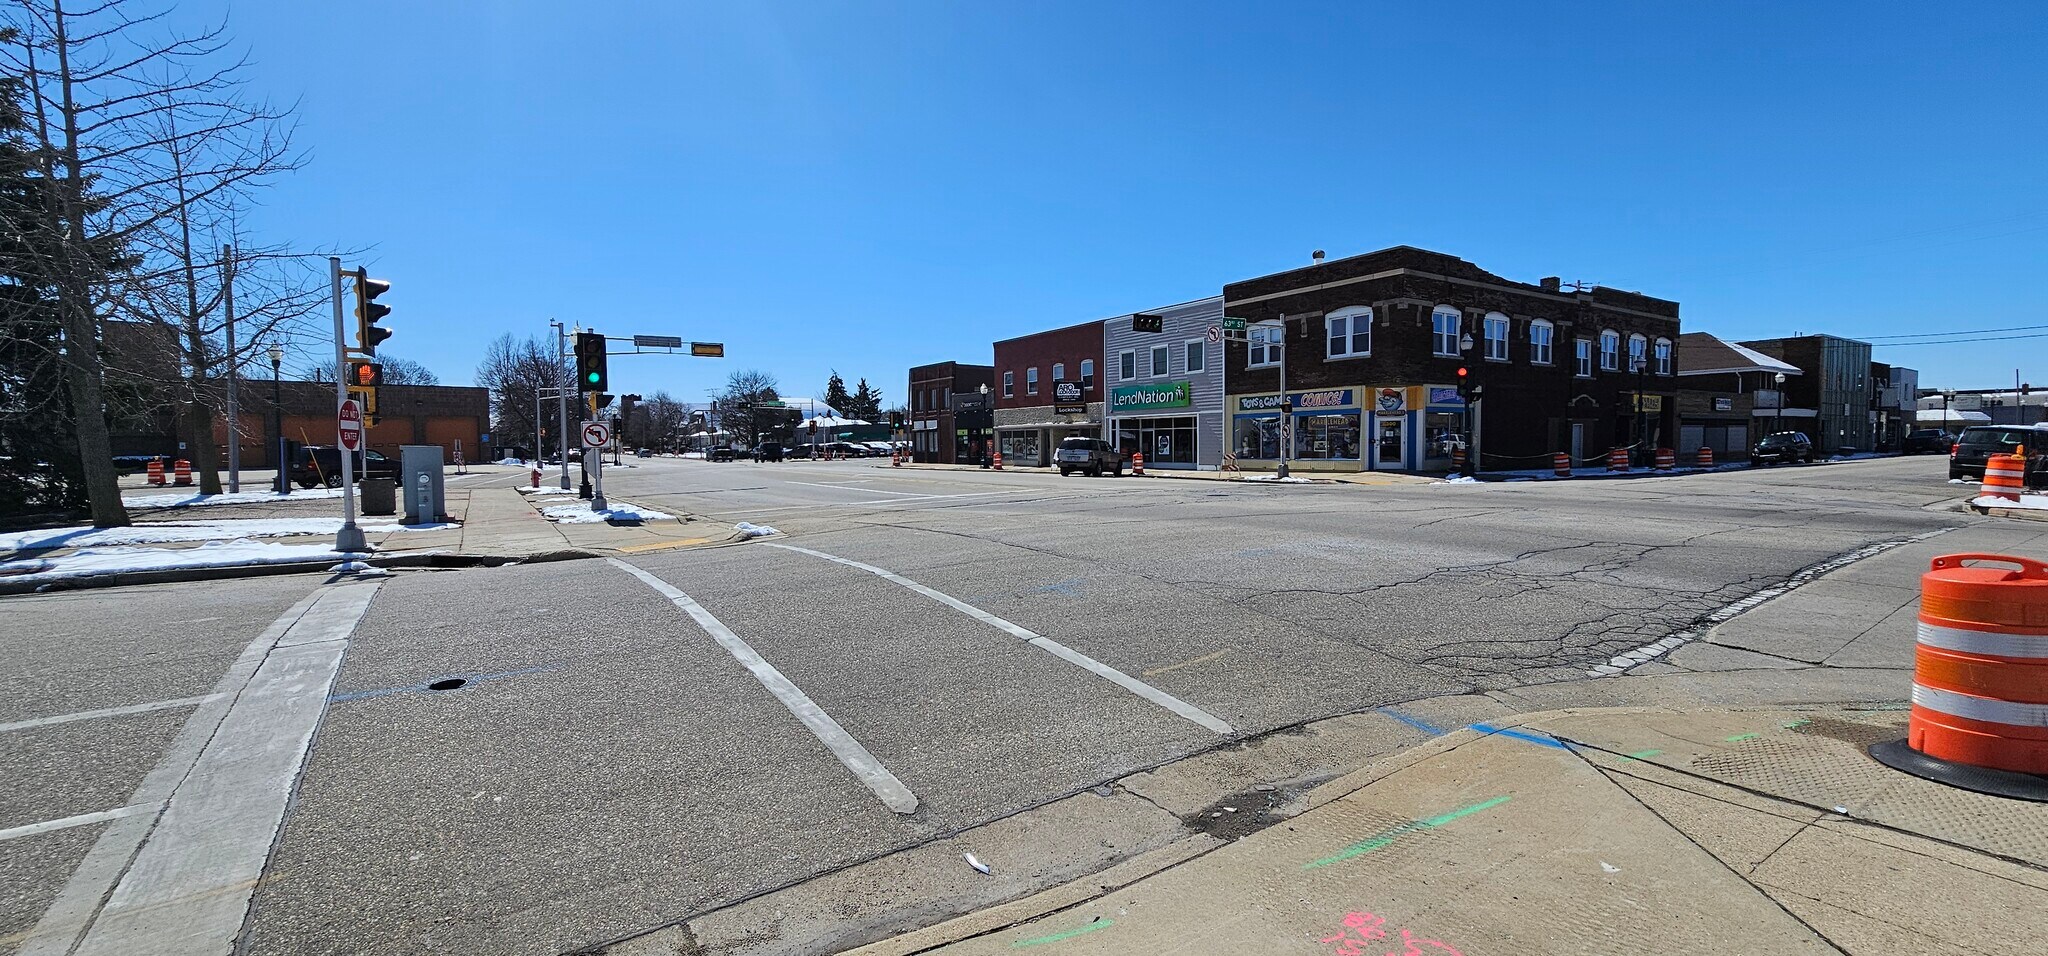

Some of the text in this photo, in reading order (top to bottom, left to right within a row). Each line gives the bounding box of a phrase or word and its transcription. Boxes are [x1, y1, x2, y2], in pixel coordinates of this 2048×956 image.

[1236, 320, 1244, 328] ST
[1114, 390, 1174, 406] LendNation
[1241, 397, 1258, 408] TOYS
[1264, 396, 1291, 408] GAMS
[1300, 391, 1345, 407] COMICS!
[342, 409, 358, 418] DO NOT
[344, 432, 358, 440] ENTER
